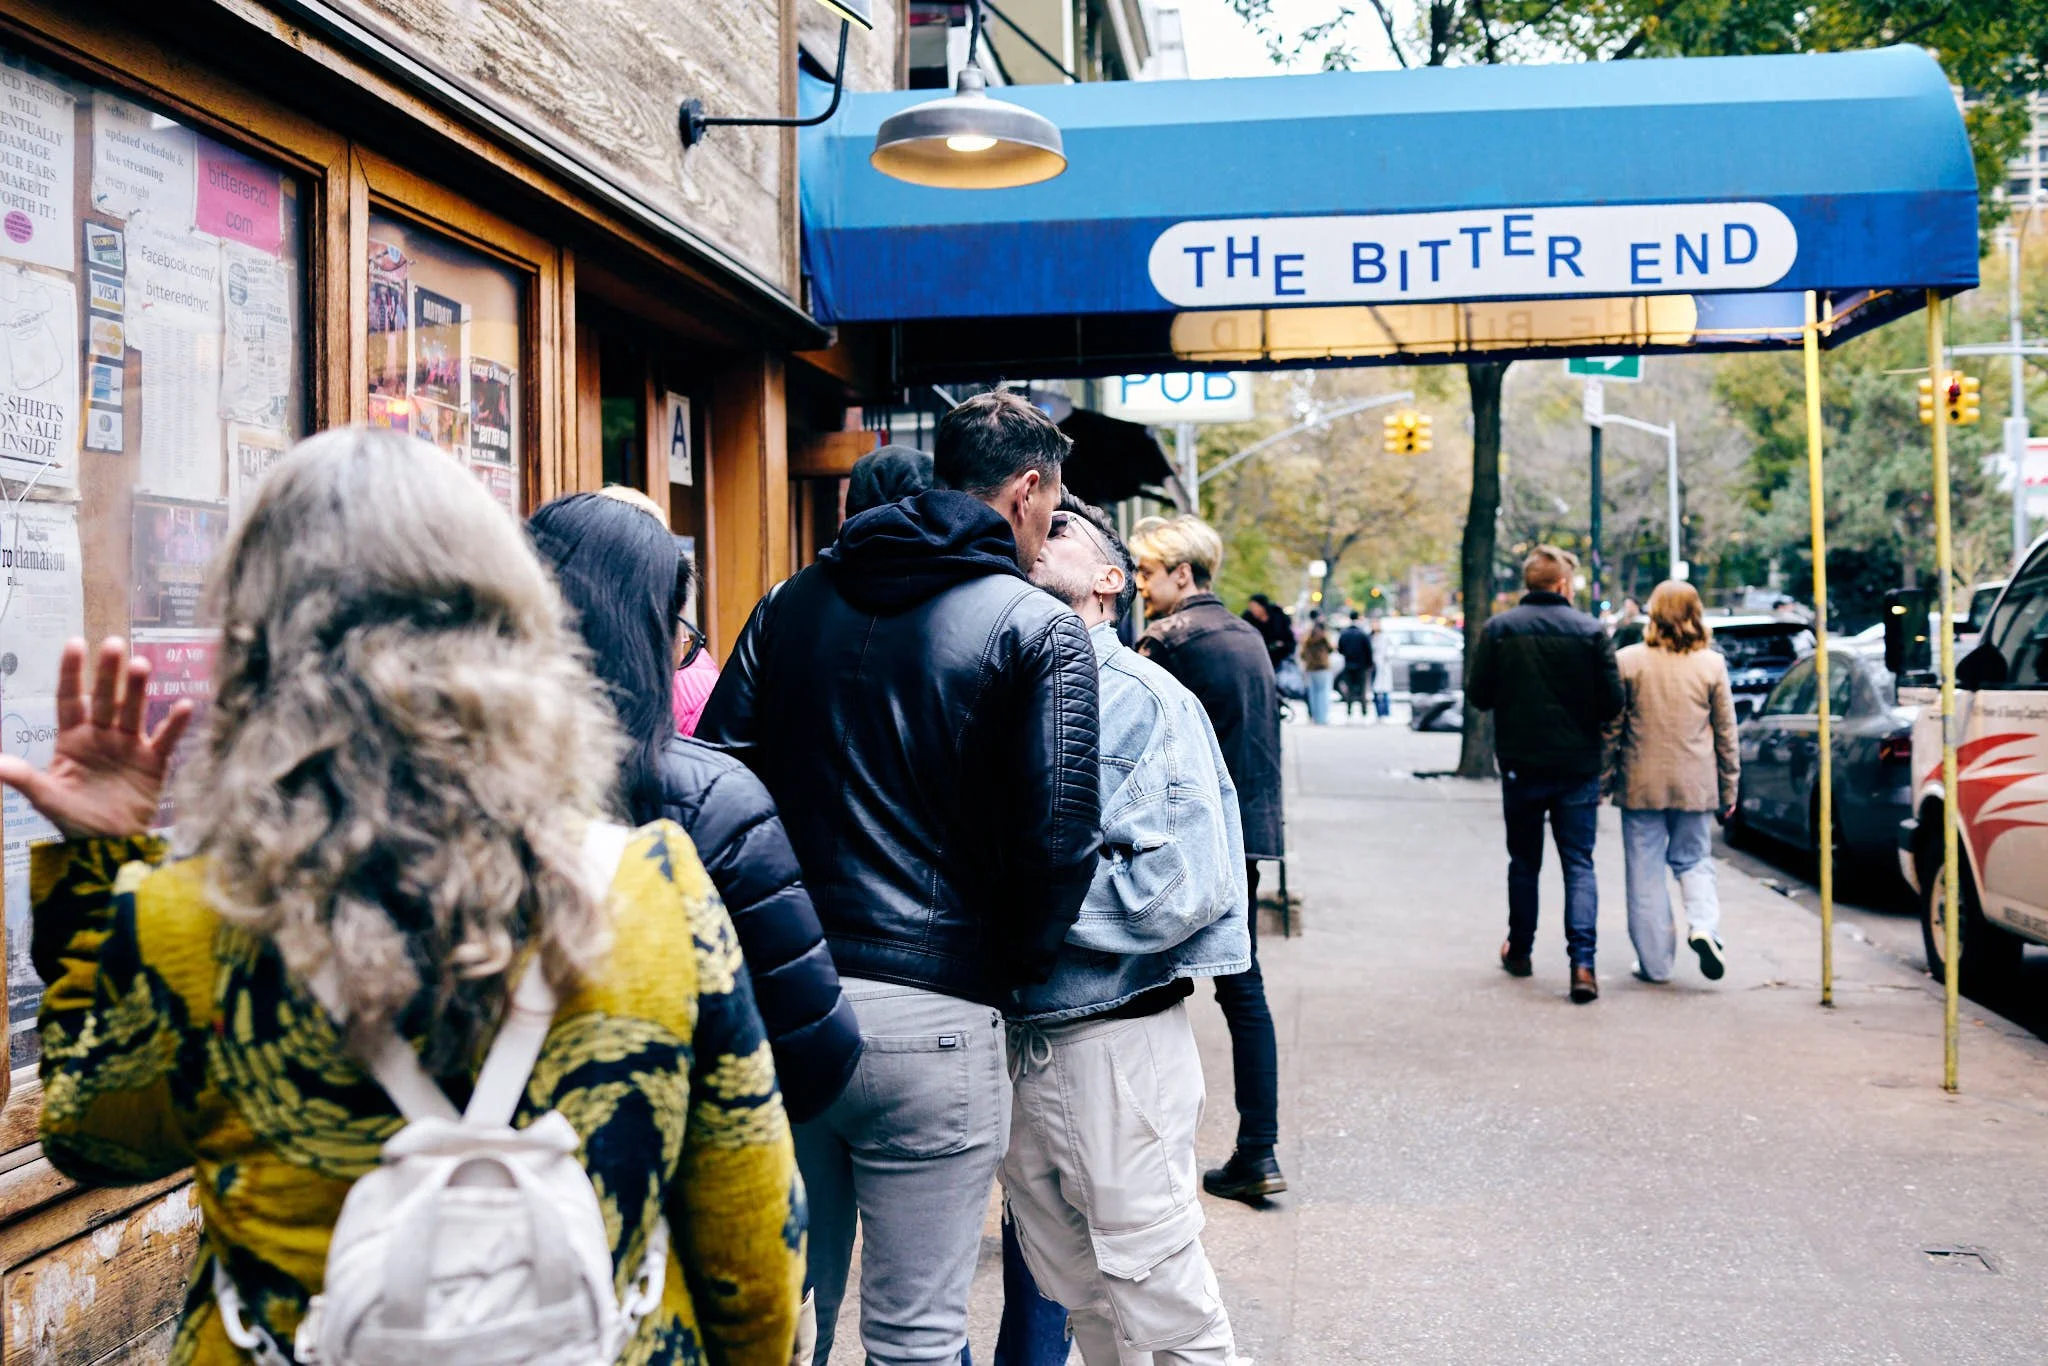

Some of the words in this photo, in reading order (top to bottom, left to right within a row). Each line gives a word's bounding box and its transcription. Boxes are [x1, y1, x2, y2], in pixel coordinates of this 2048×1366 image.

[8, 94, 41, 119] WILL
[0, 110, 63, 147] ENTUALLY
[105, 128, 141, 149] updated
[142, 141, 175, 162] schedule
[106, 149, 121, 166] live
[122, 158, 164, 182] streaming
[0, 190, 35, 213] ORTH
[1183, 235, 1306, 296] THE
[1352, 214, 1585, 292] BITTER
[1630, 223, 1758, 284] END
[97, 285, 118, 301] VISA
[146, 280, 209, 312] bitterendnyc
[1120, 372, 1236, 404] PUB
[2, 432, 56, 458] INSIDE
[25, 418, 63, 441] SALE
[671, 405, 687, 458] A
[2, 545, 65, 571] roclamation
